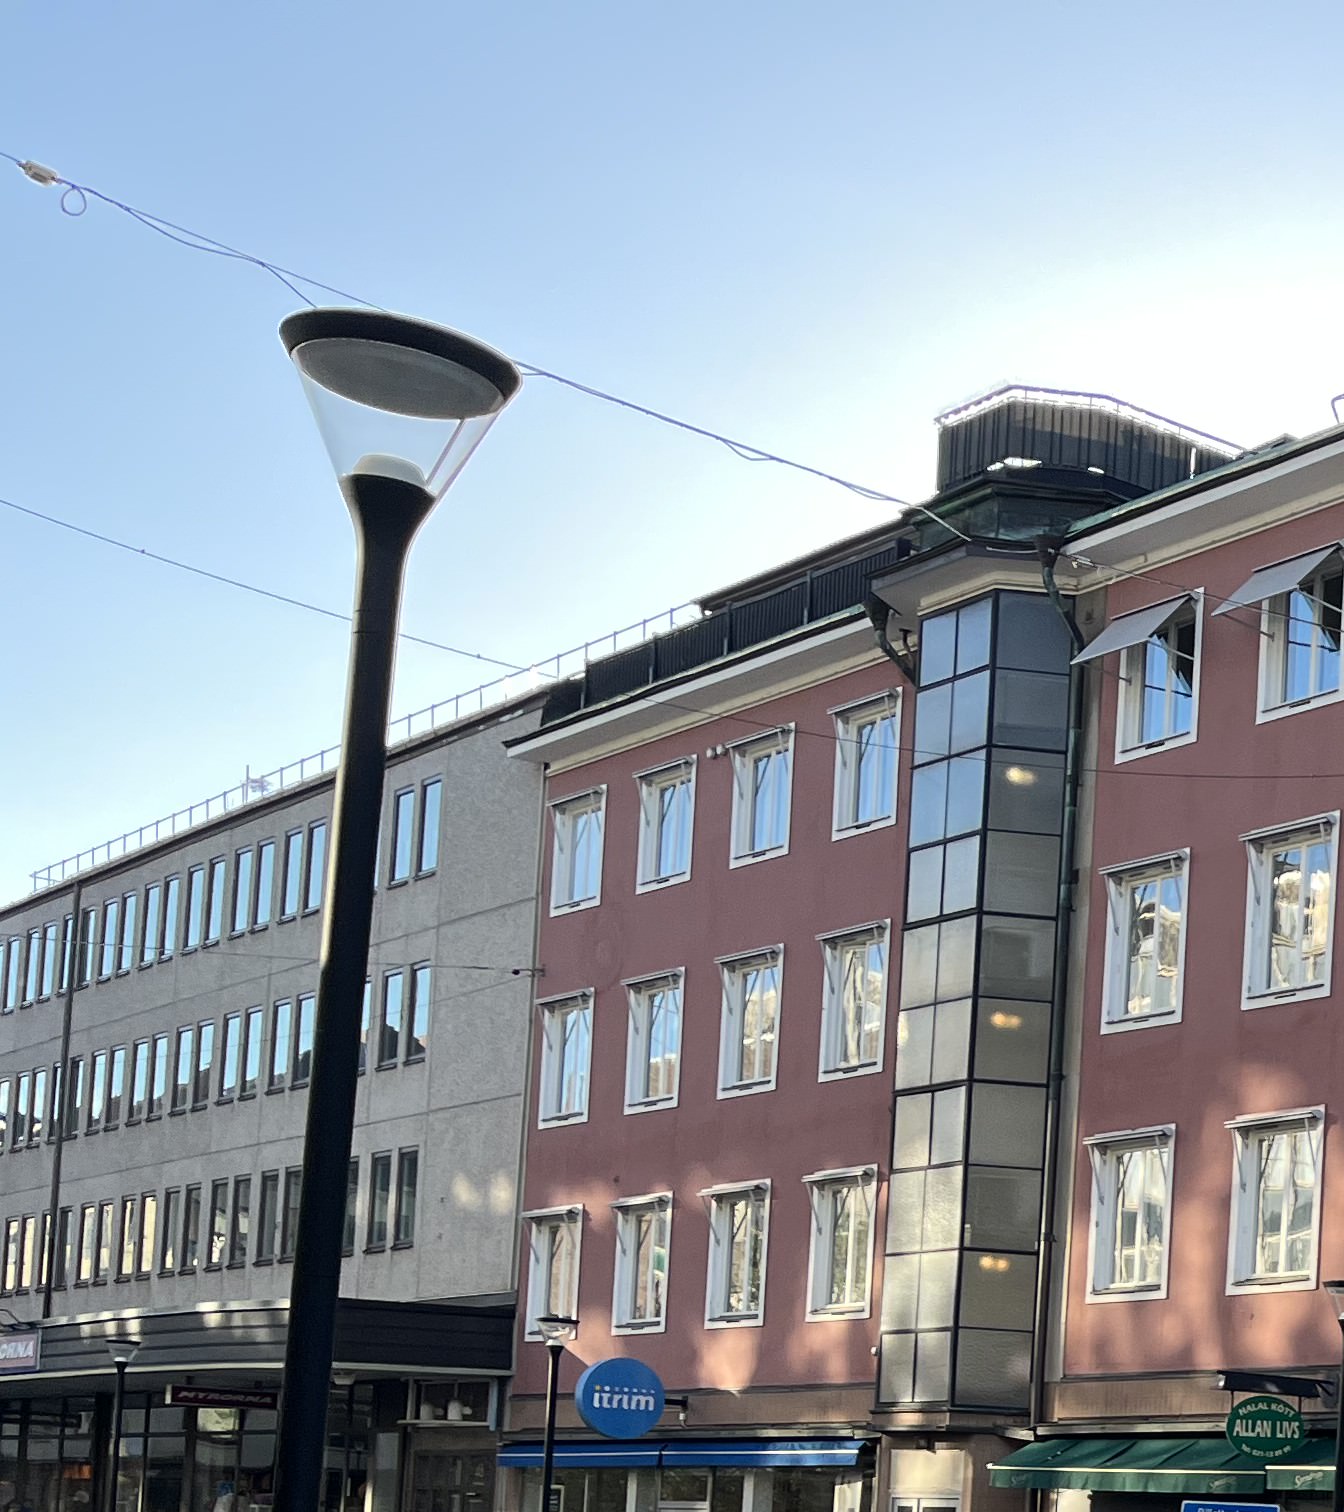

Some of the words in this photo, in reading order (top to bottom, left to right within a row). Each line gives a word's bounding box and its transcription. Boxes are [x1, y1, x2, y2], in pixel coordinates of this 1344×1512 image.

[592, 1384, 655, 1411] itrim
[1238, 1402, 1269, 1416] HALAL
[1232, 1419, 1272, 1438] ALLAN
[1276, 1420, 1300, 1439] LIVS
